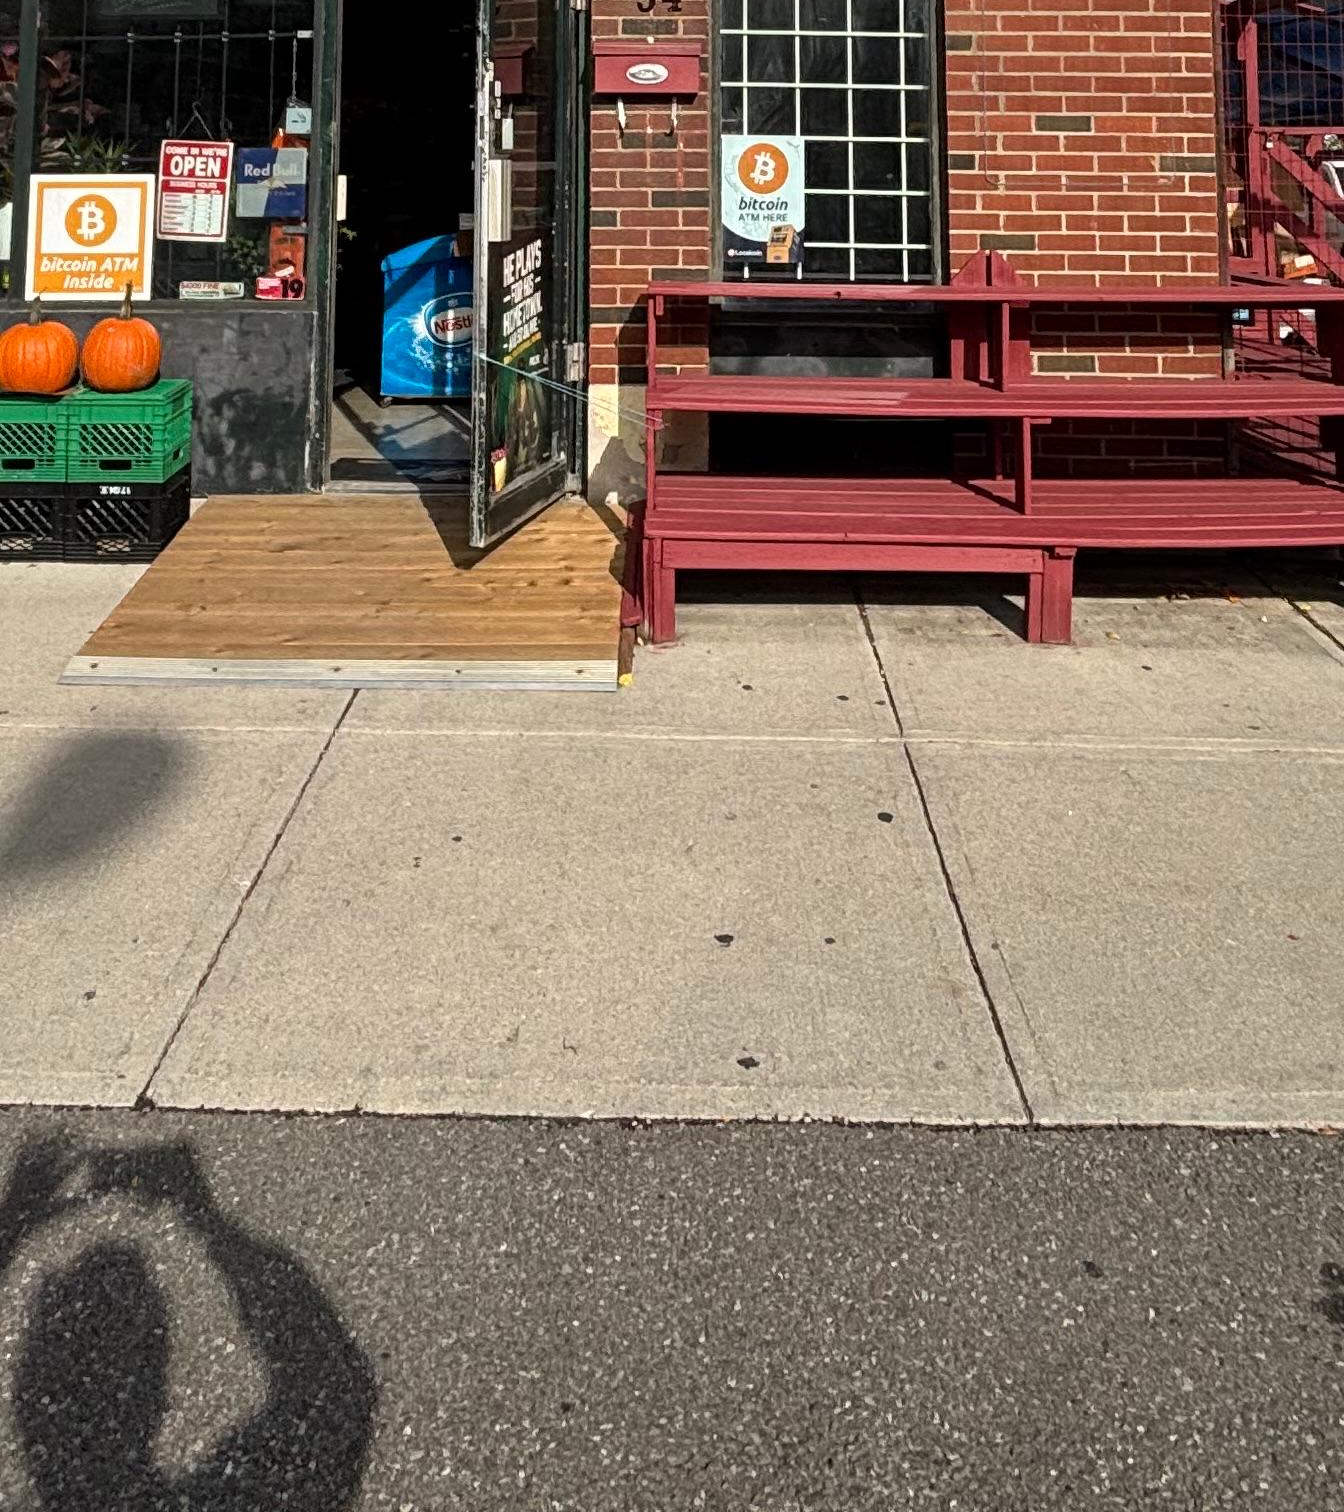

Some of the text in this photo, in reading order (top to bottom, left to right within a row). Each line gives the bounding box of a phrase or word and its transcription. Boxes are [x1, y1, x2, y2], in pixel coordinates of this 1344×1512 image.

[170, 155, 221, 177] OPEN
[244, 163, 270, 176] Red
[739, 197, 788, 210] bitcoin
[738, 213, 788, 221] ATM HERE
[40, 256, 139, 272] bitcoin ATM
[503, 239, 542, 288] HE PLAYS
[280, 278, 304, 298] 19
[434, 313, 473, 334] Nestl
